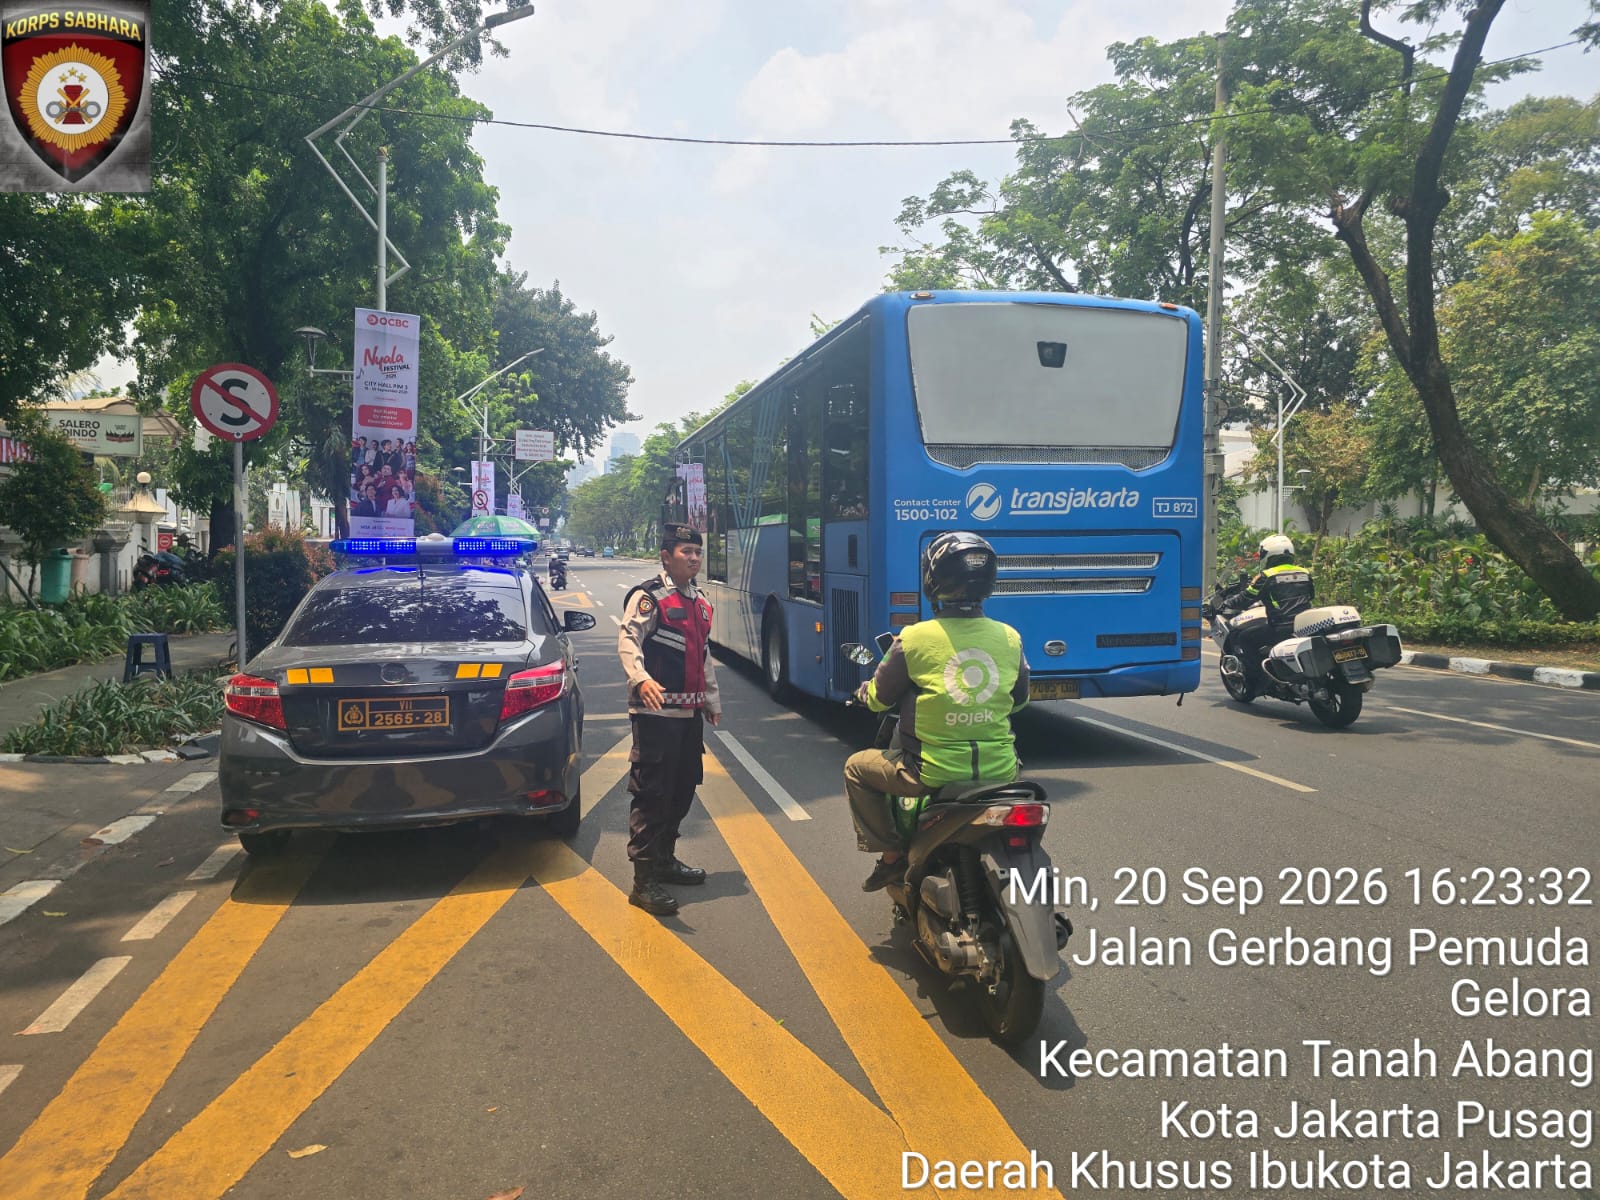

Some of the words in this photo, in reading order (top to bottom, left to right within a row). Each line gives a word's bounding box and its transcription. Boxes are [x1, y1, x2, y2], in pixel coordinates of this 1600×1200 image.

[379, 317, 409, 328] OCBC
[363, 345, 404, 371] Nyala
[383, 364, 411, 372] FESTIVAL
[220, 378, 249, 426] S
[59, 419, 101, 429] SALERO
[894, 499, 930, 507] Contact
[932, 499, 961, 507] Center
[1008, 487, 1140, 515] transjakarta
[1156, 502, 1170, 513] TJ
[1173, 502, 1193, 513] 872
[895, 509, 958, 521] 1500-102
[945, 710, 993, 727] gojek
